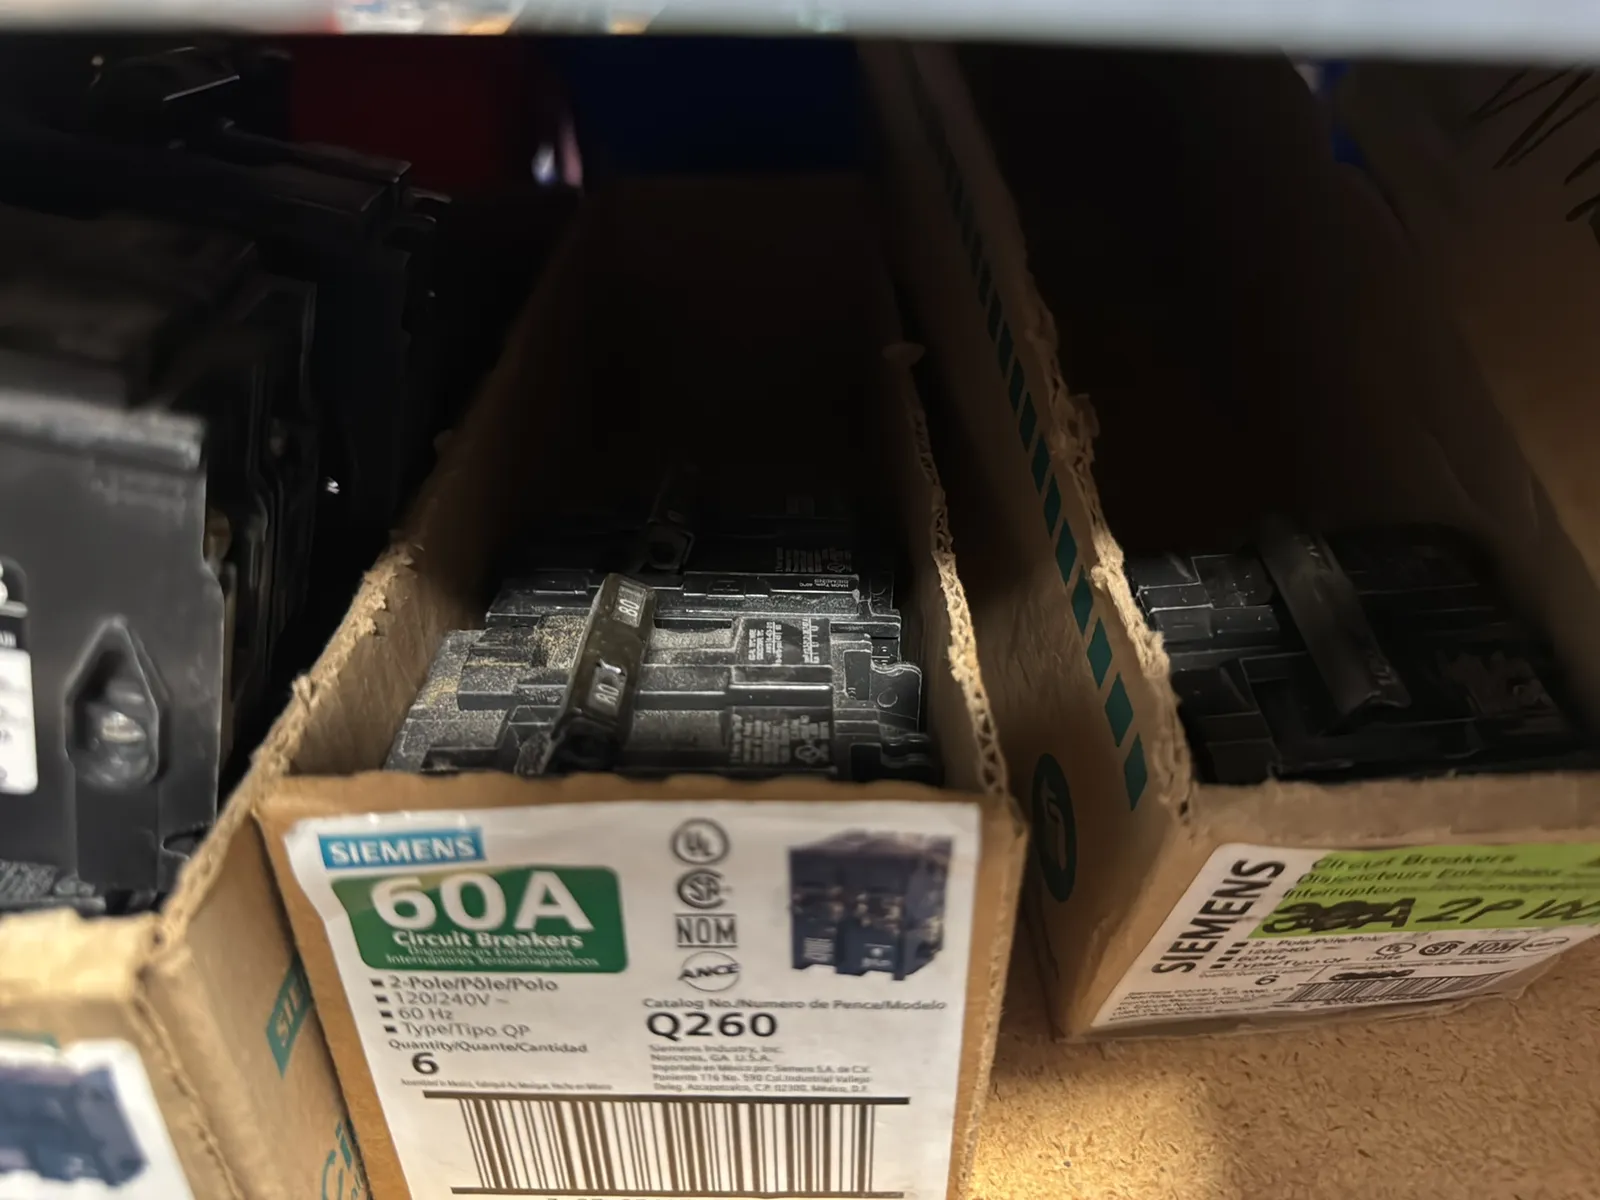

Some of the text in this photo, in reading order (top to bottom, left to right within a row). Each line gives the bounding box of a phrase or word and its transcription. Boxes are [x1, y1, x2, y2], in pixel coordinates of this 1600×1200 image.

[329, 836, 475, 864] SIEMENS
[370, 870, 595, 933] 60A
[1151, 858, 1286, 975] SIEMENS
[392, 931, 584, 948] Circuit Breakers
[676, 916, 738, 944] NOM
[1255, 975, 1280, 985] 6
[399, 1007, 453, 1021] 60 Hz
[646, 1011, 778, 1042] Q260
[402, 1021, 531, 1040] Type/Tipo QP
[411, 1052, 440, 1076] 6
